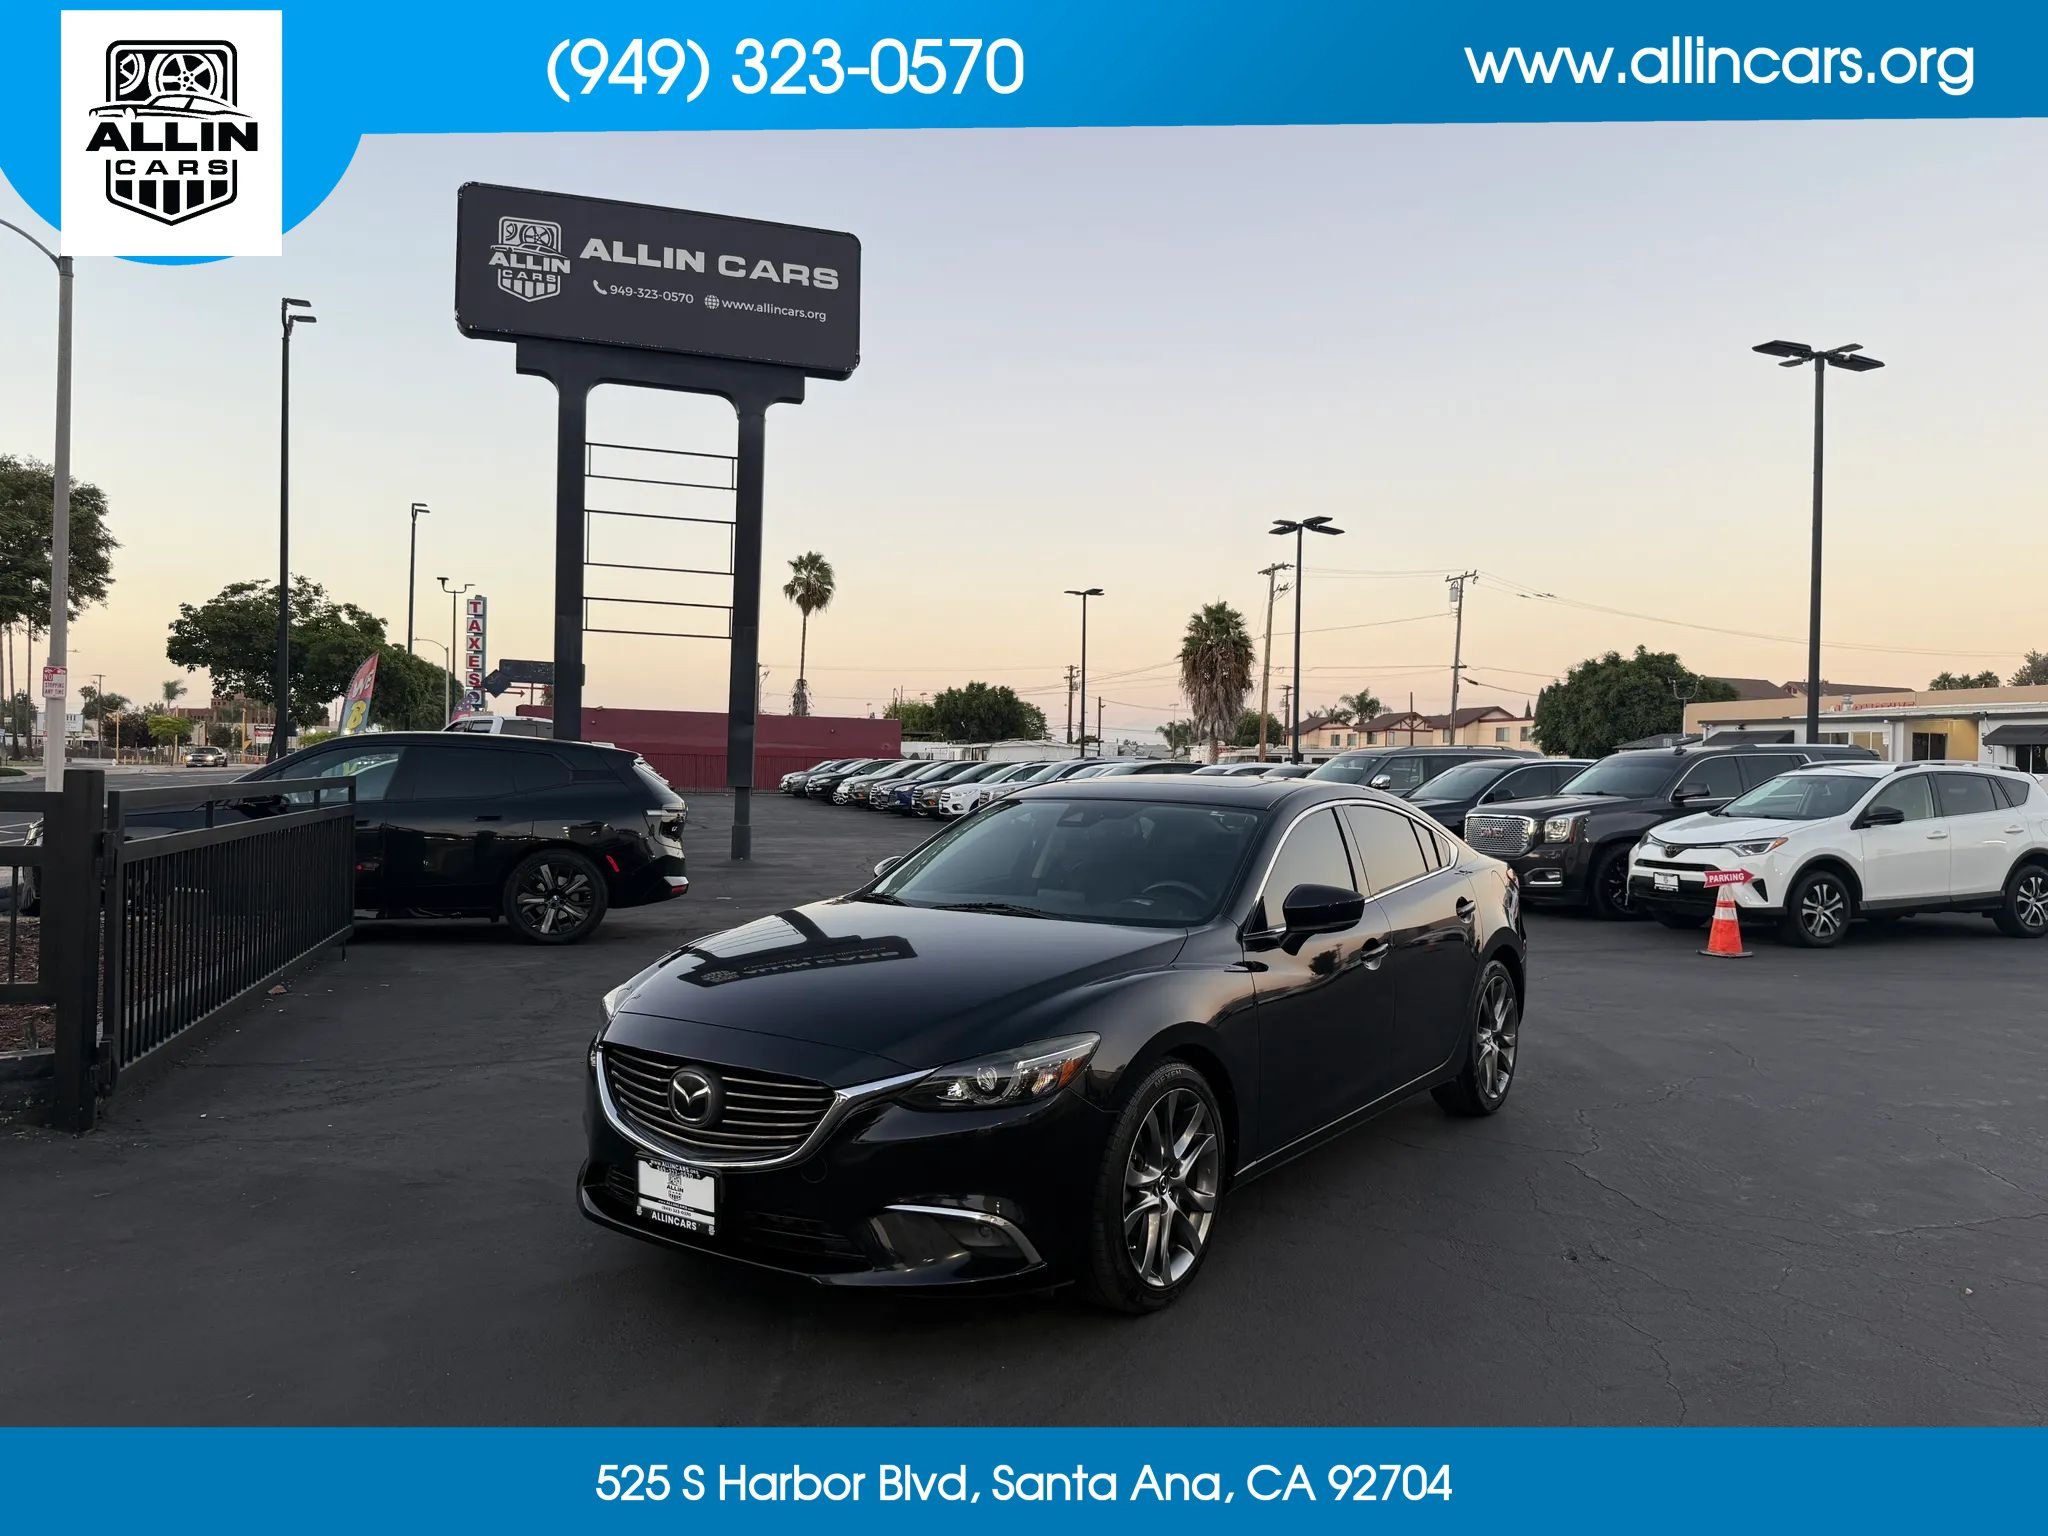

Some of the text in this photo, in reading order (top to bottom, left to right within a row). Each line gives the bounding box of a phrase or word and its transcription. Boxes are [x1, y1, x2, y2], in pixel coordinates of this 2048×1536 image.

[488, 251, 571, 275] ALLIN
[580, 237, 840, 291] ALLIN CARS
[502, 268, 557, 283] CARS
[609, 283, 694, 305] 949-323-0570
[721, 298, 827, 323] www.allincars.org
[468, 601, 482, 687] TAXES
[1709, 872, 1745, 884] PARKING
[651, 1211, 697, 1231] ALLINCARS
